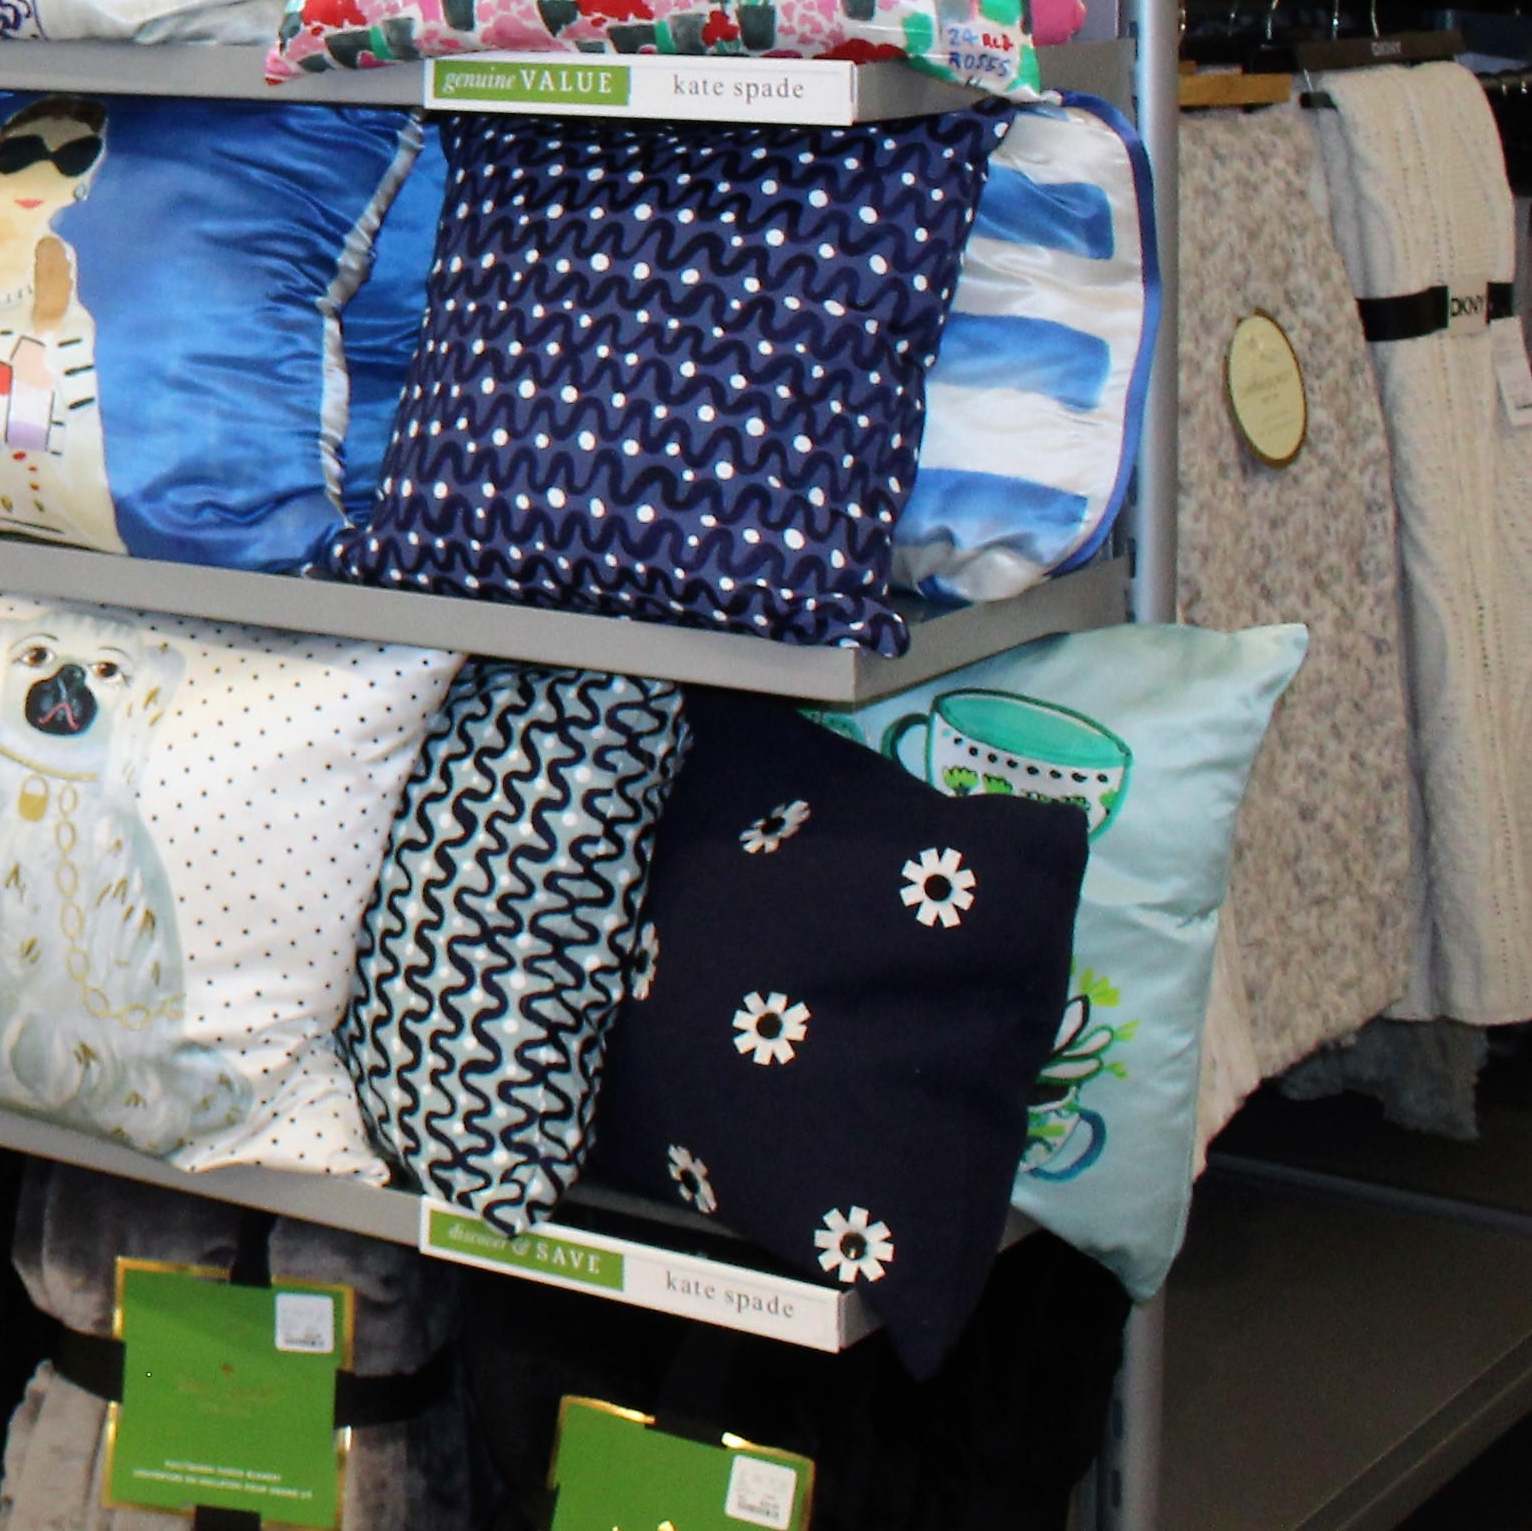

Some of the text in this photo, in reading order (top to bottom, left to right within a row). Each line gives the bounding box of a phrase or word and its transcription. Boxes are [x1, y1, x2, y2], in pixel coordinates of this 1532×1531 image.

[444, 68, 805, 104] genuine VALUE kate spade
[1450, 295, 1485, 317] DKNY
[537, 1244, 602, 1274] SAVE
[665, 1271, 717, 1300] kate
[724, 1289, 797, 1319] spade
